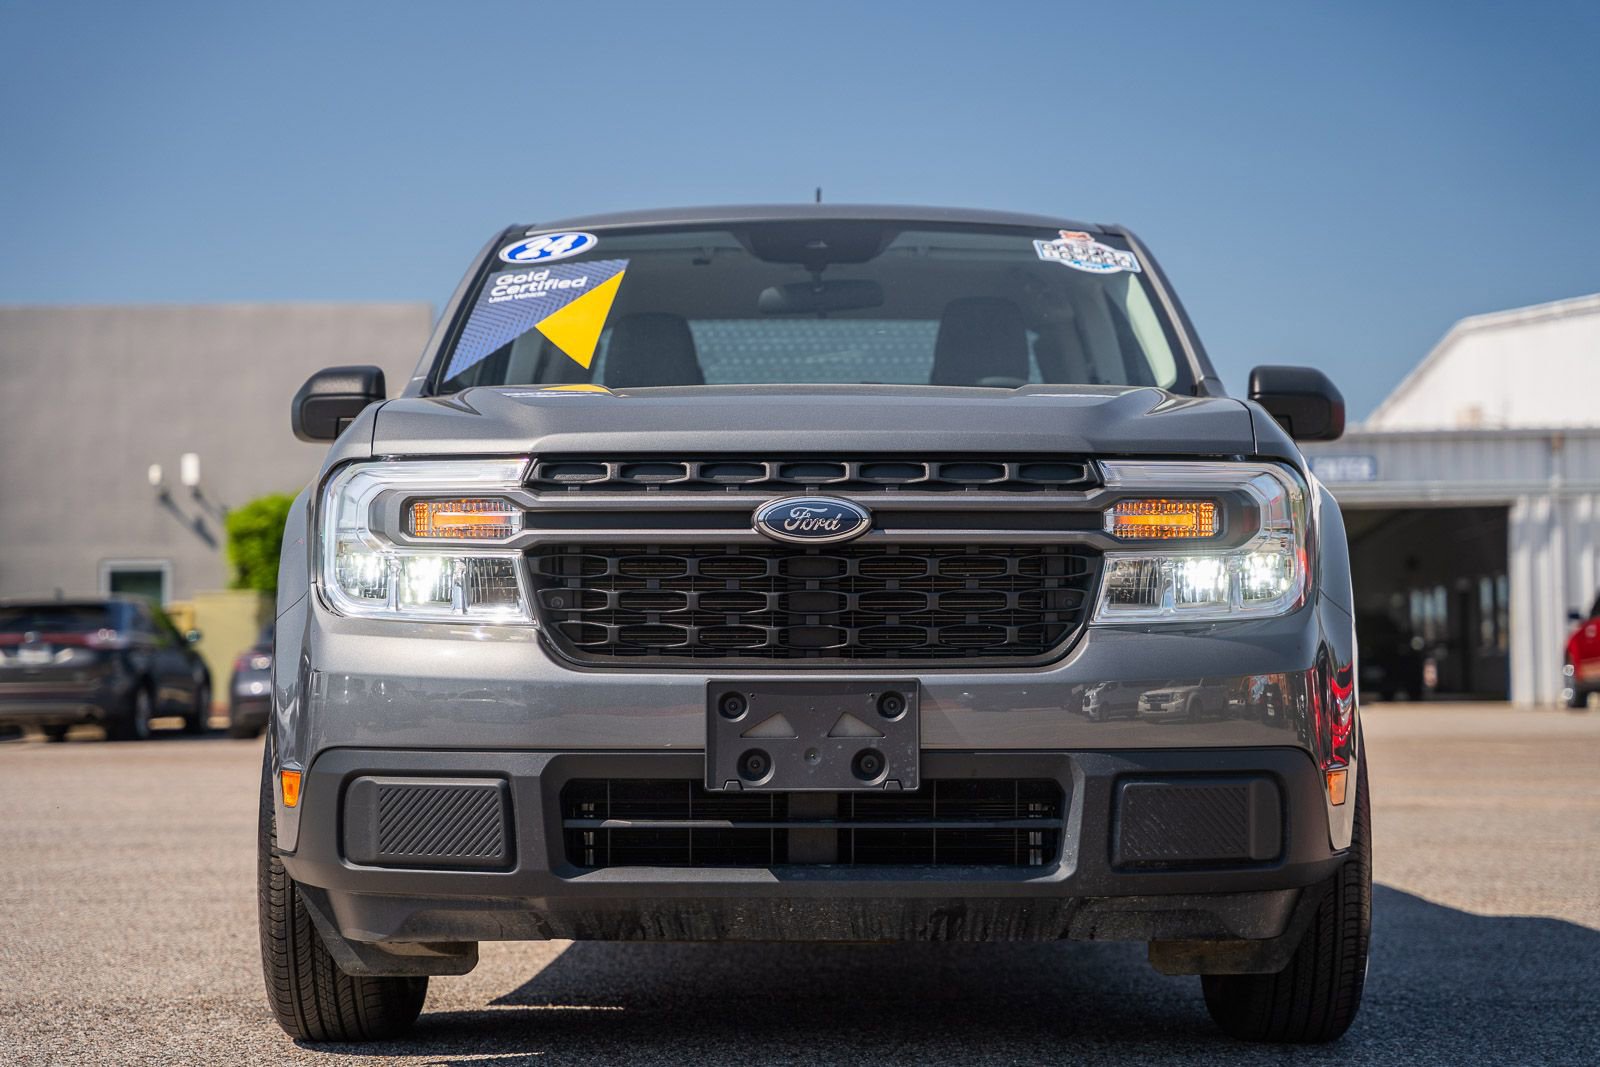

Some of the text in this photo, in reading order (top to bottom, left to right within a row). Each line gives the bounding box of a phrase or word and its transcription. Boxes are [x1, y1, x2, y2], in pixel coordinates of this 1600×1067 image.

[515, 233, 580, 260] 24
[491, 276, 589, 297] Certified
[496, 269, 551, 286] Gold
[784, 506, 842, 531] Ford
